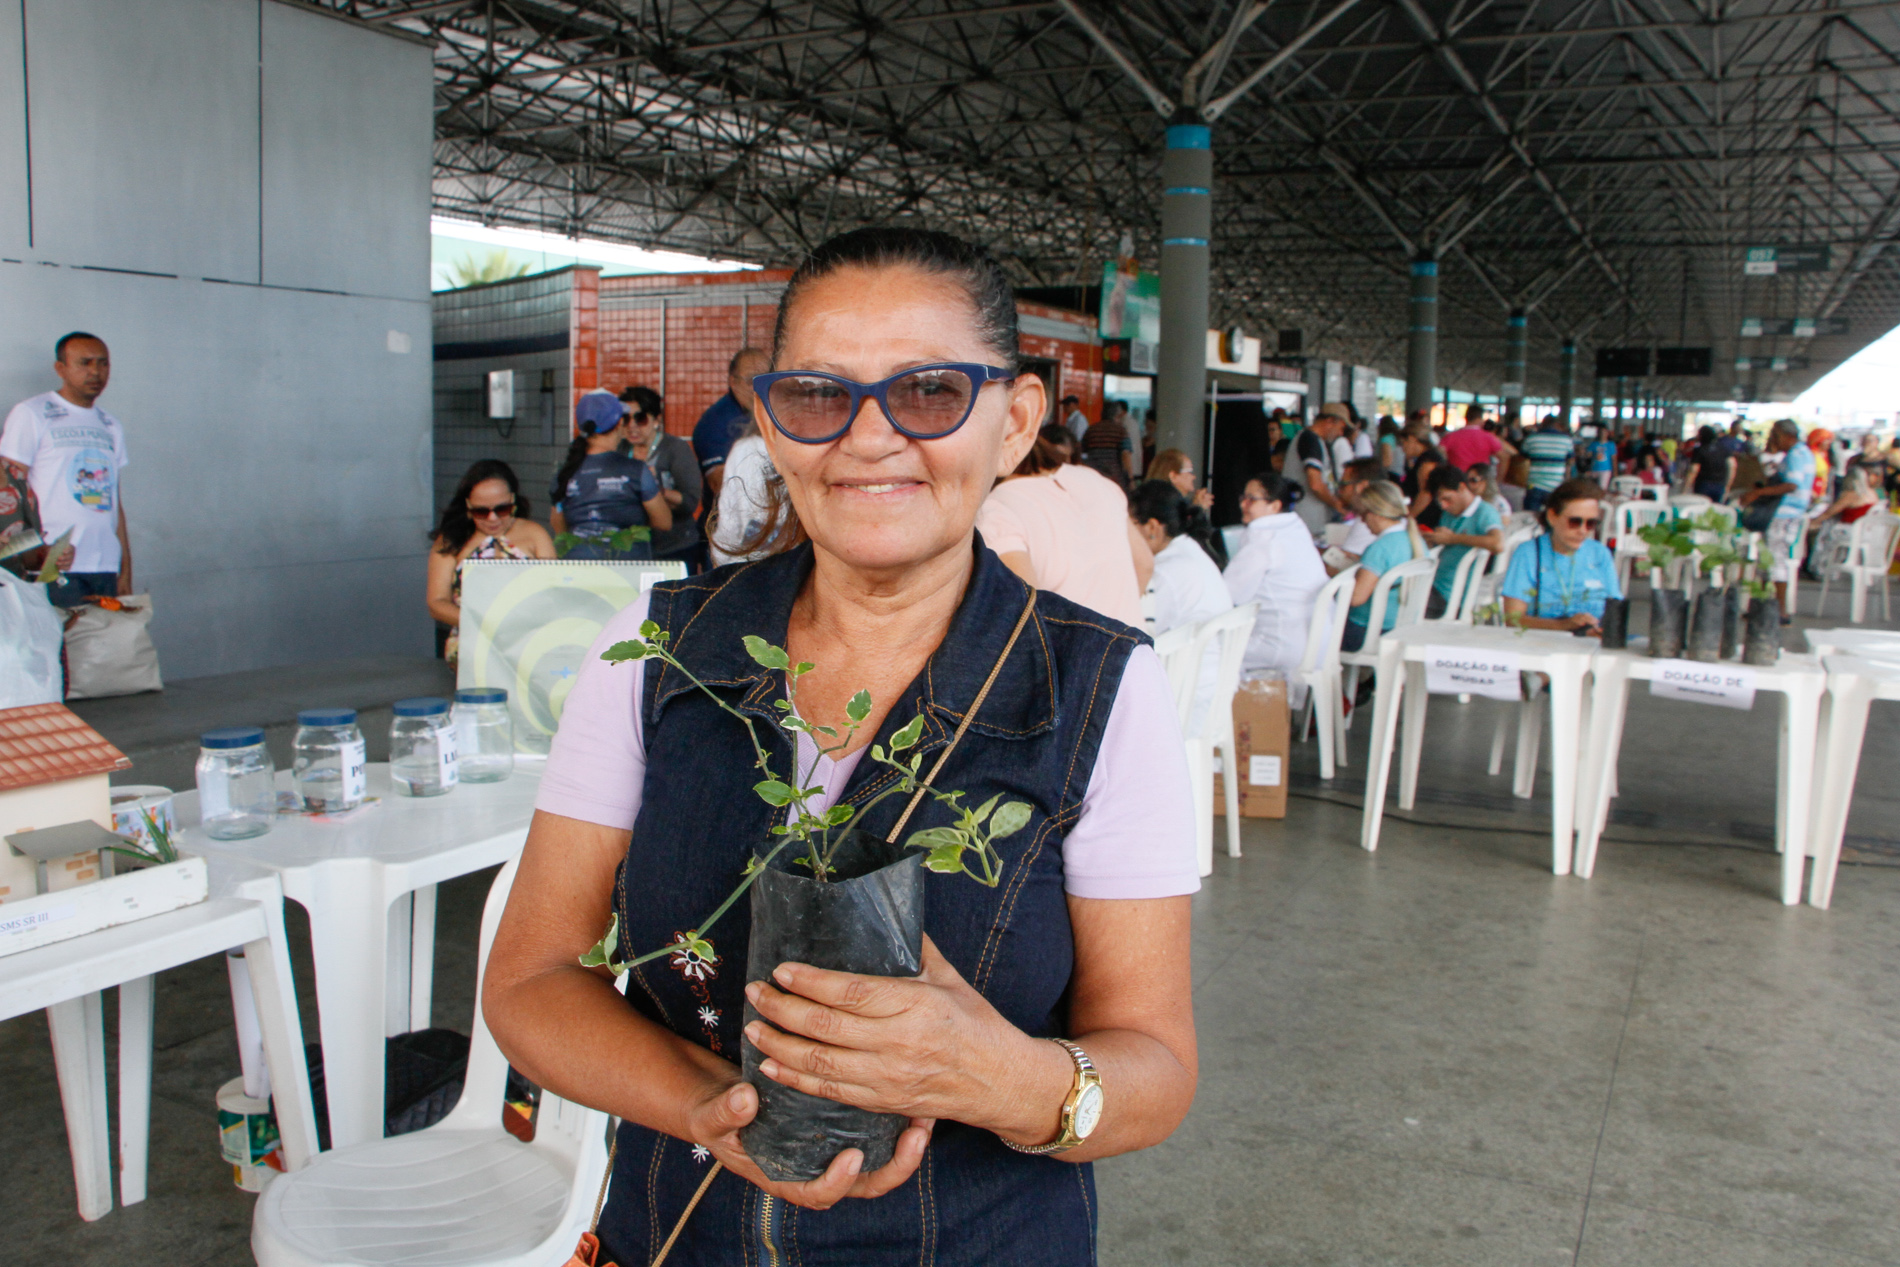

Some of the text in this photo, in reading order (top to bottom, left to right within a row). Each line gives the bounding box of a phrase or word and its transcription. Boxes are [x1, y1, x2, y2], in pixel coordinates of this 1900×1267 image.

[1435, 659, 1508, 672] DOAÇÃO DE
[1664, 670, 1744, 688] DOAÇÃO DE
[22, 915, 36, 926] SR
